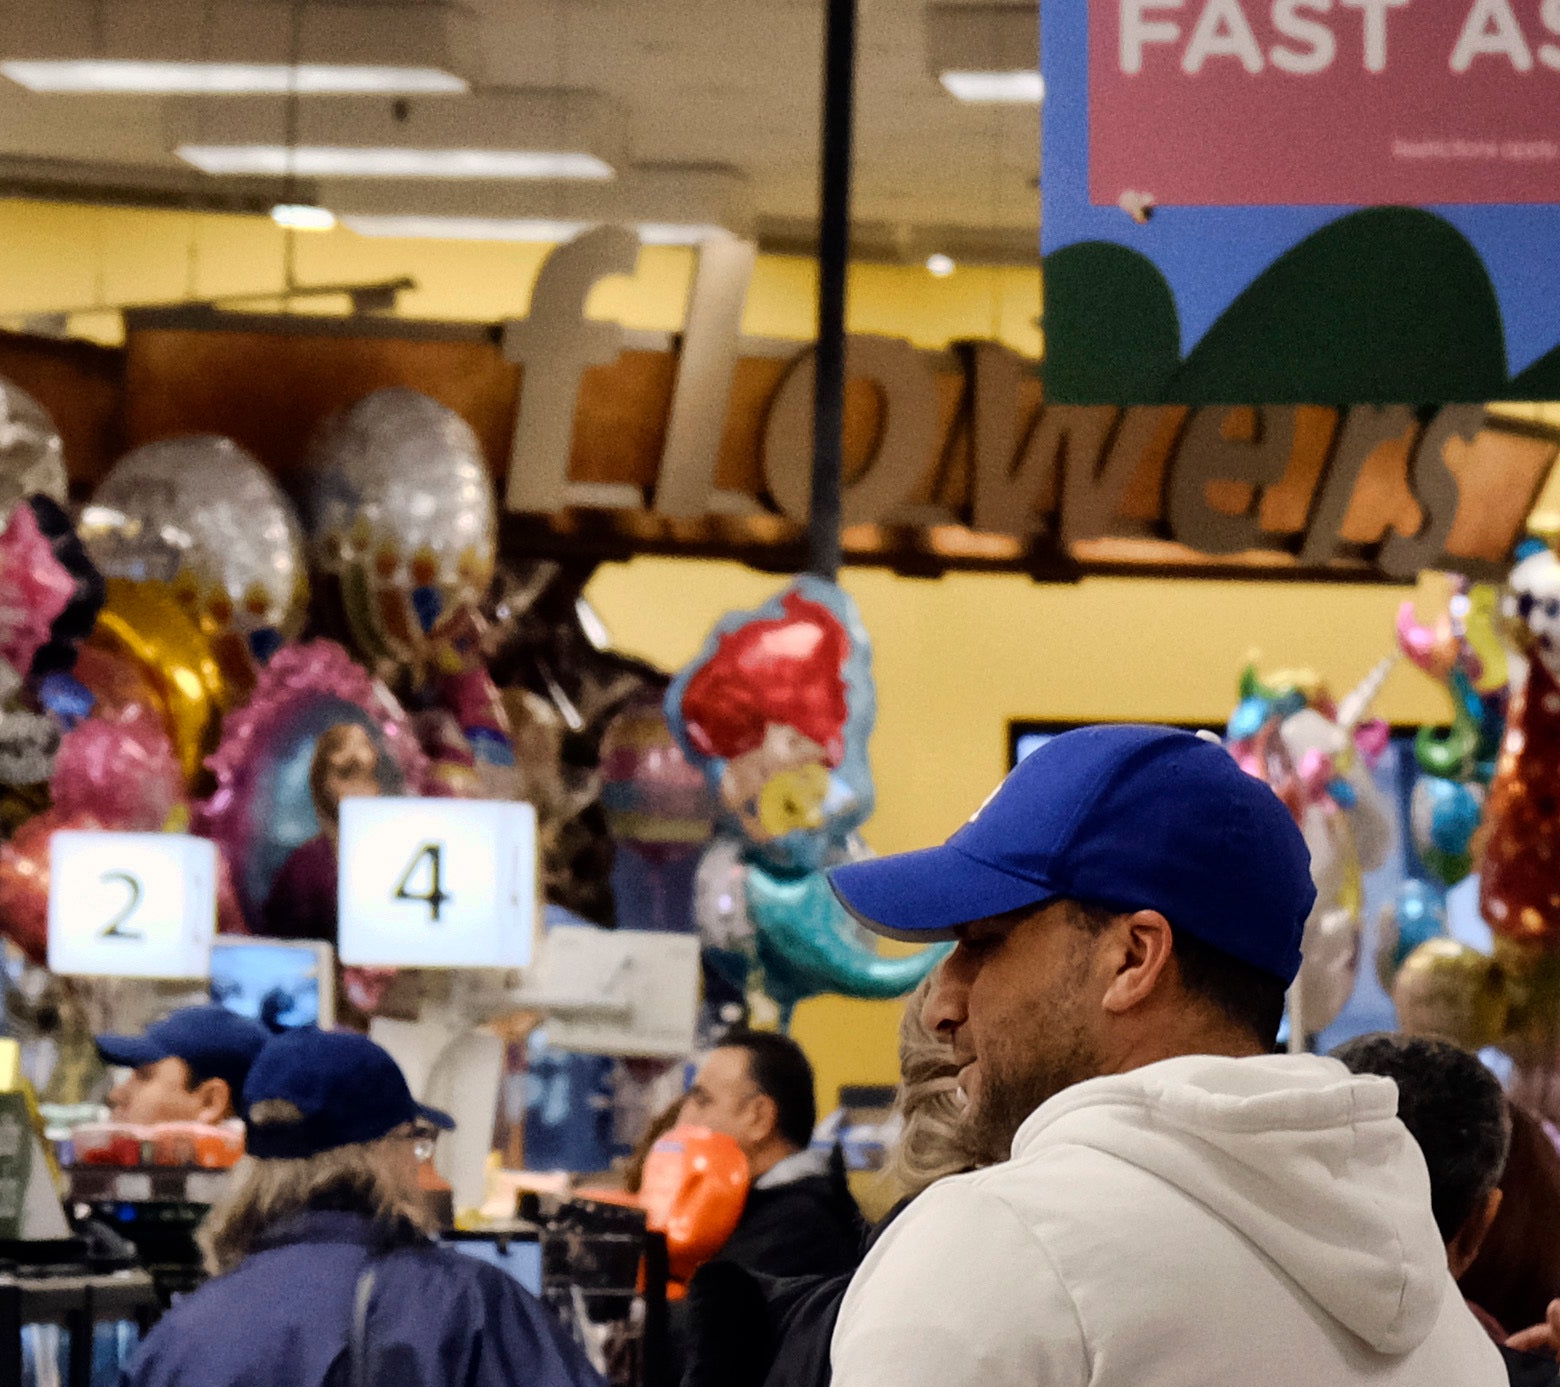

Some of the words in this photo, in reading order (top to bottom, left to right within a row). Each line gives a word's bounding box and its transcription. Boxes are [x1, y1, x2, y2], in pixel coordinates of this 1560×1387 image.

[1118, 0, 1408, 74] FAST
[502, 222, 1486, 580] flowers
[98, 868, 144, 941] 2
[391, 841, 453, 924] 4
